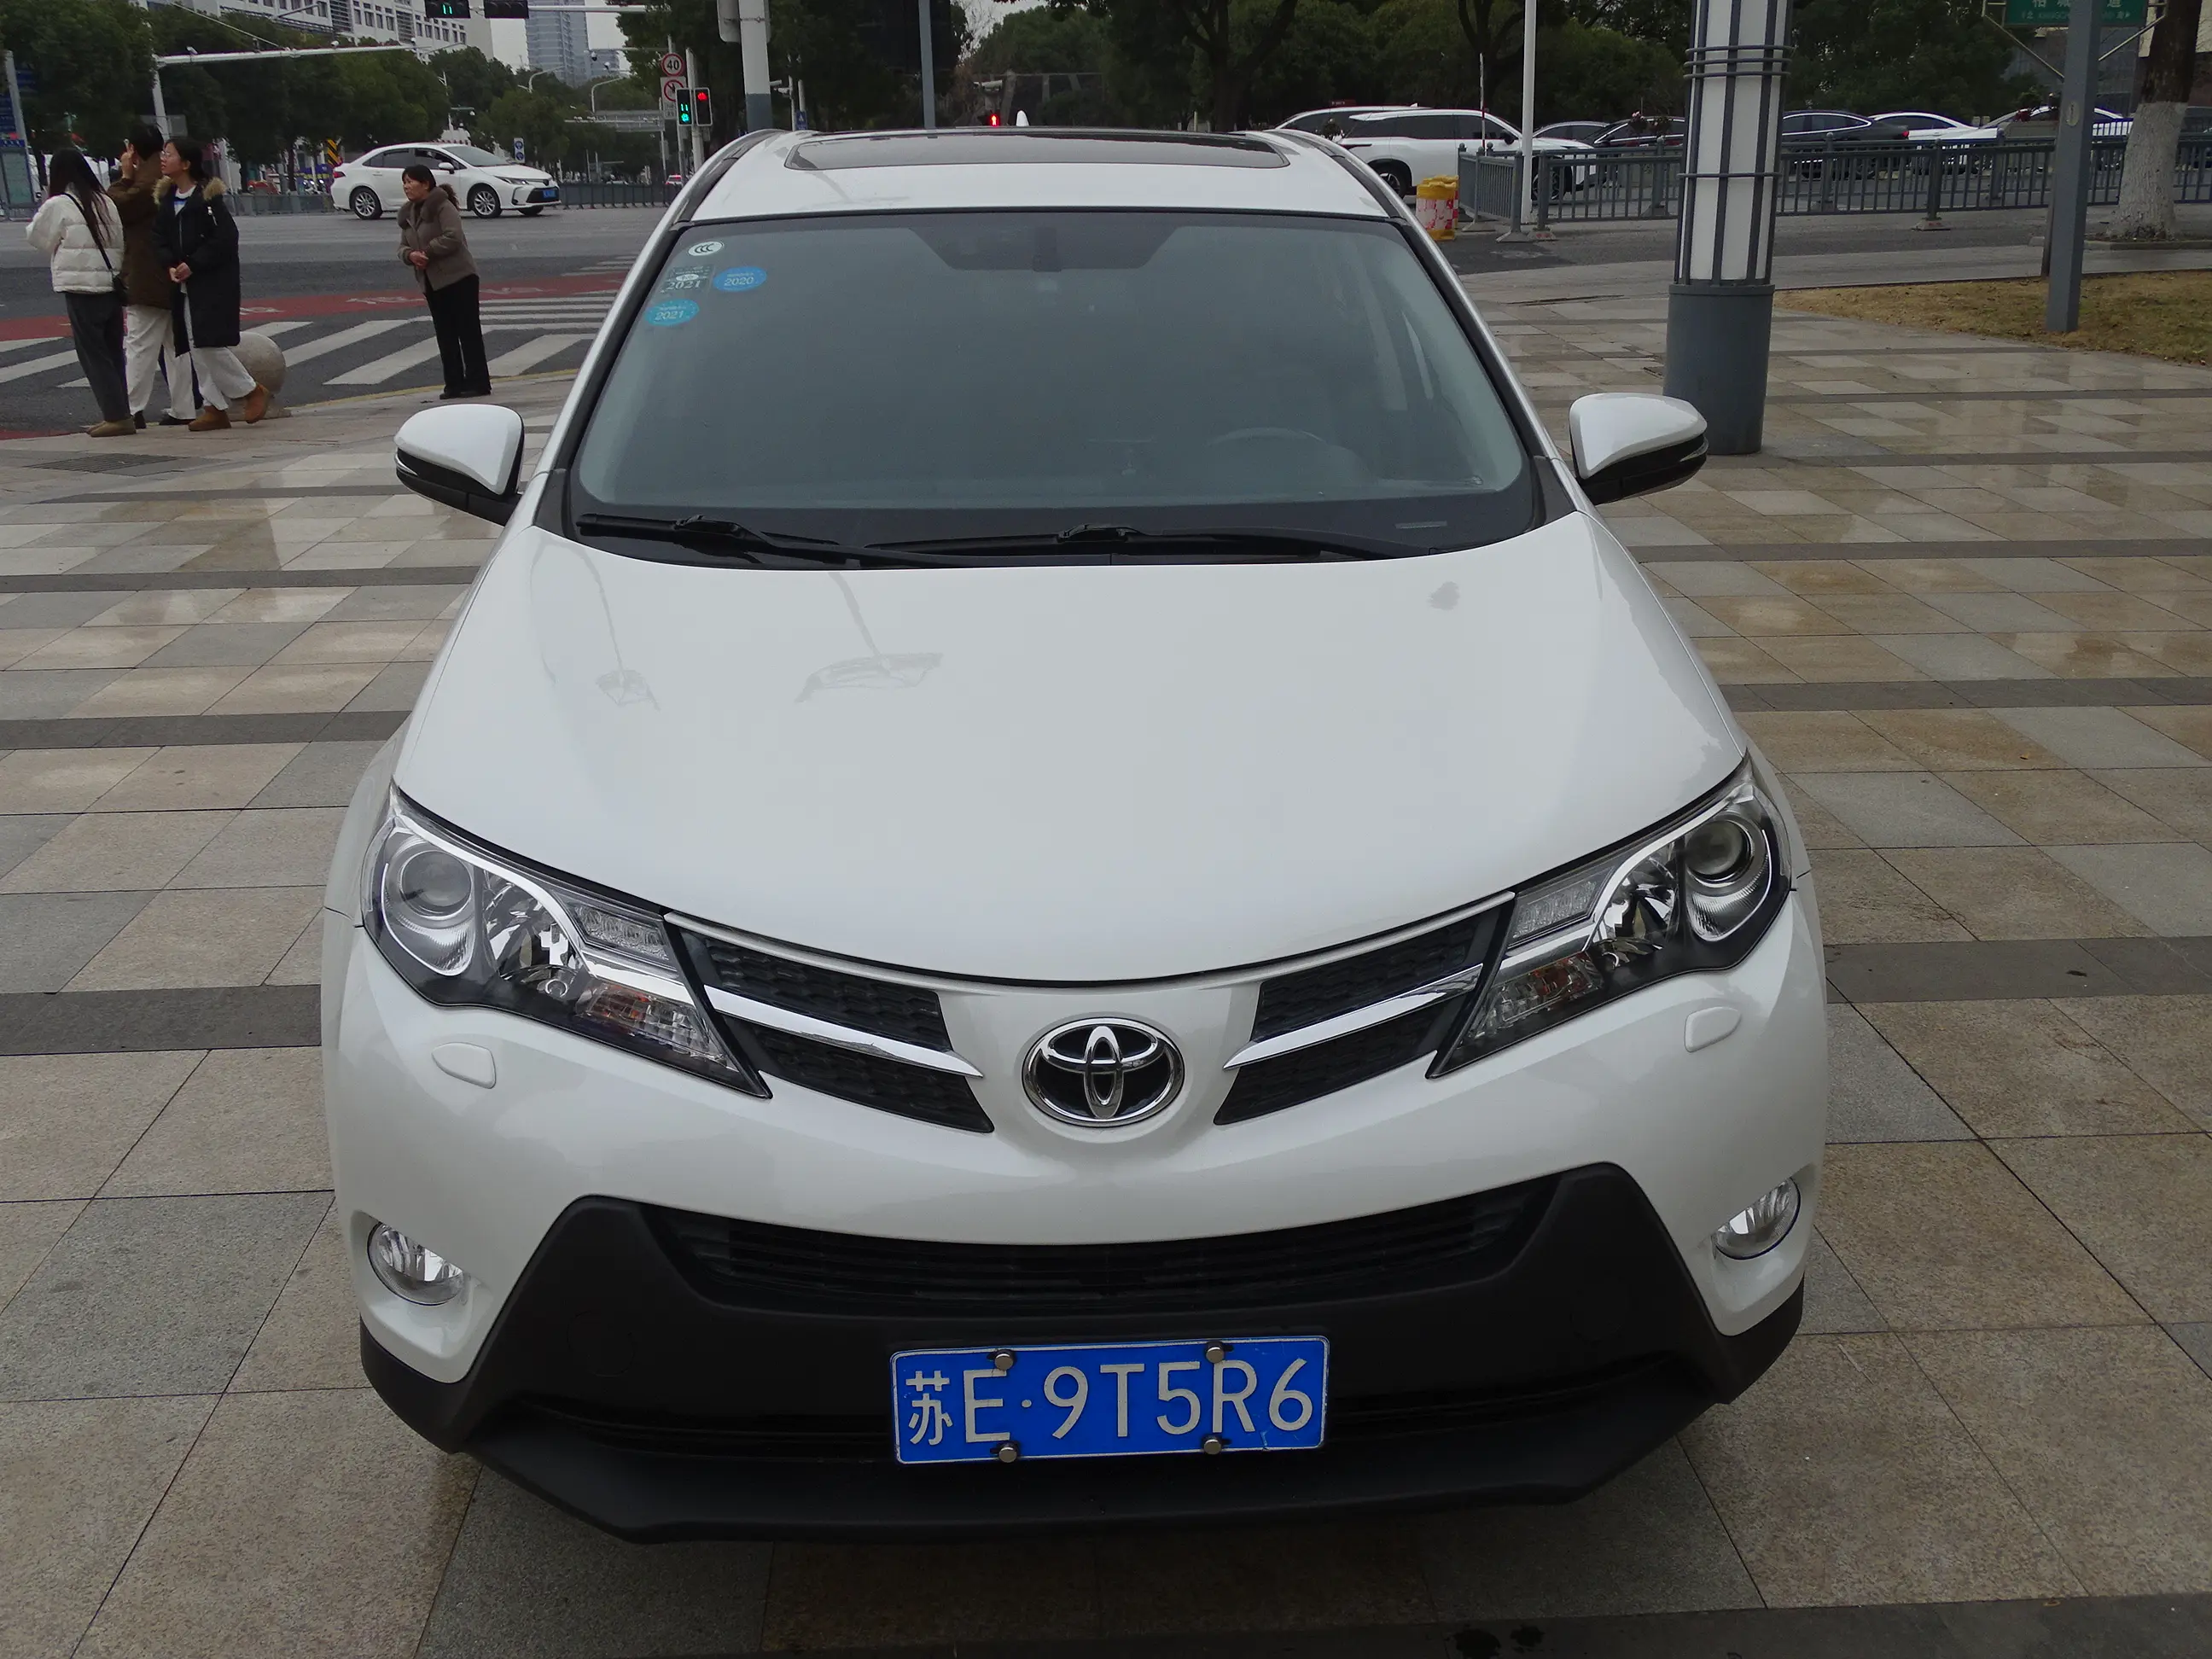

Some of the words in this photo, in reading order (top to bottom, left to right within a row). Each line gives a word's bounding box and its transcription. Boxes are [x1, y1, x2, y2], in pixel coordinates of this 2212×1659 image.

[667, 60, 679, 70] 40
[694, 243, 714, 253] CCC
[666, 279, 701, 290] 2021
[723, 276, 754, 287] 2020
[655, 310, 684, 322] 2021
[905, 1358, 1313, 1446] 苏E·9T5R6
